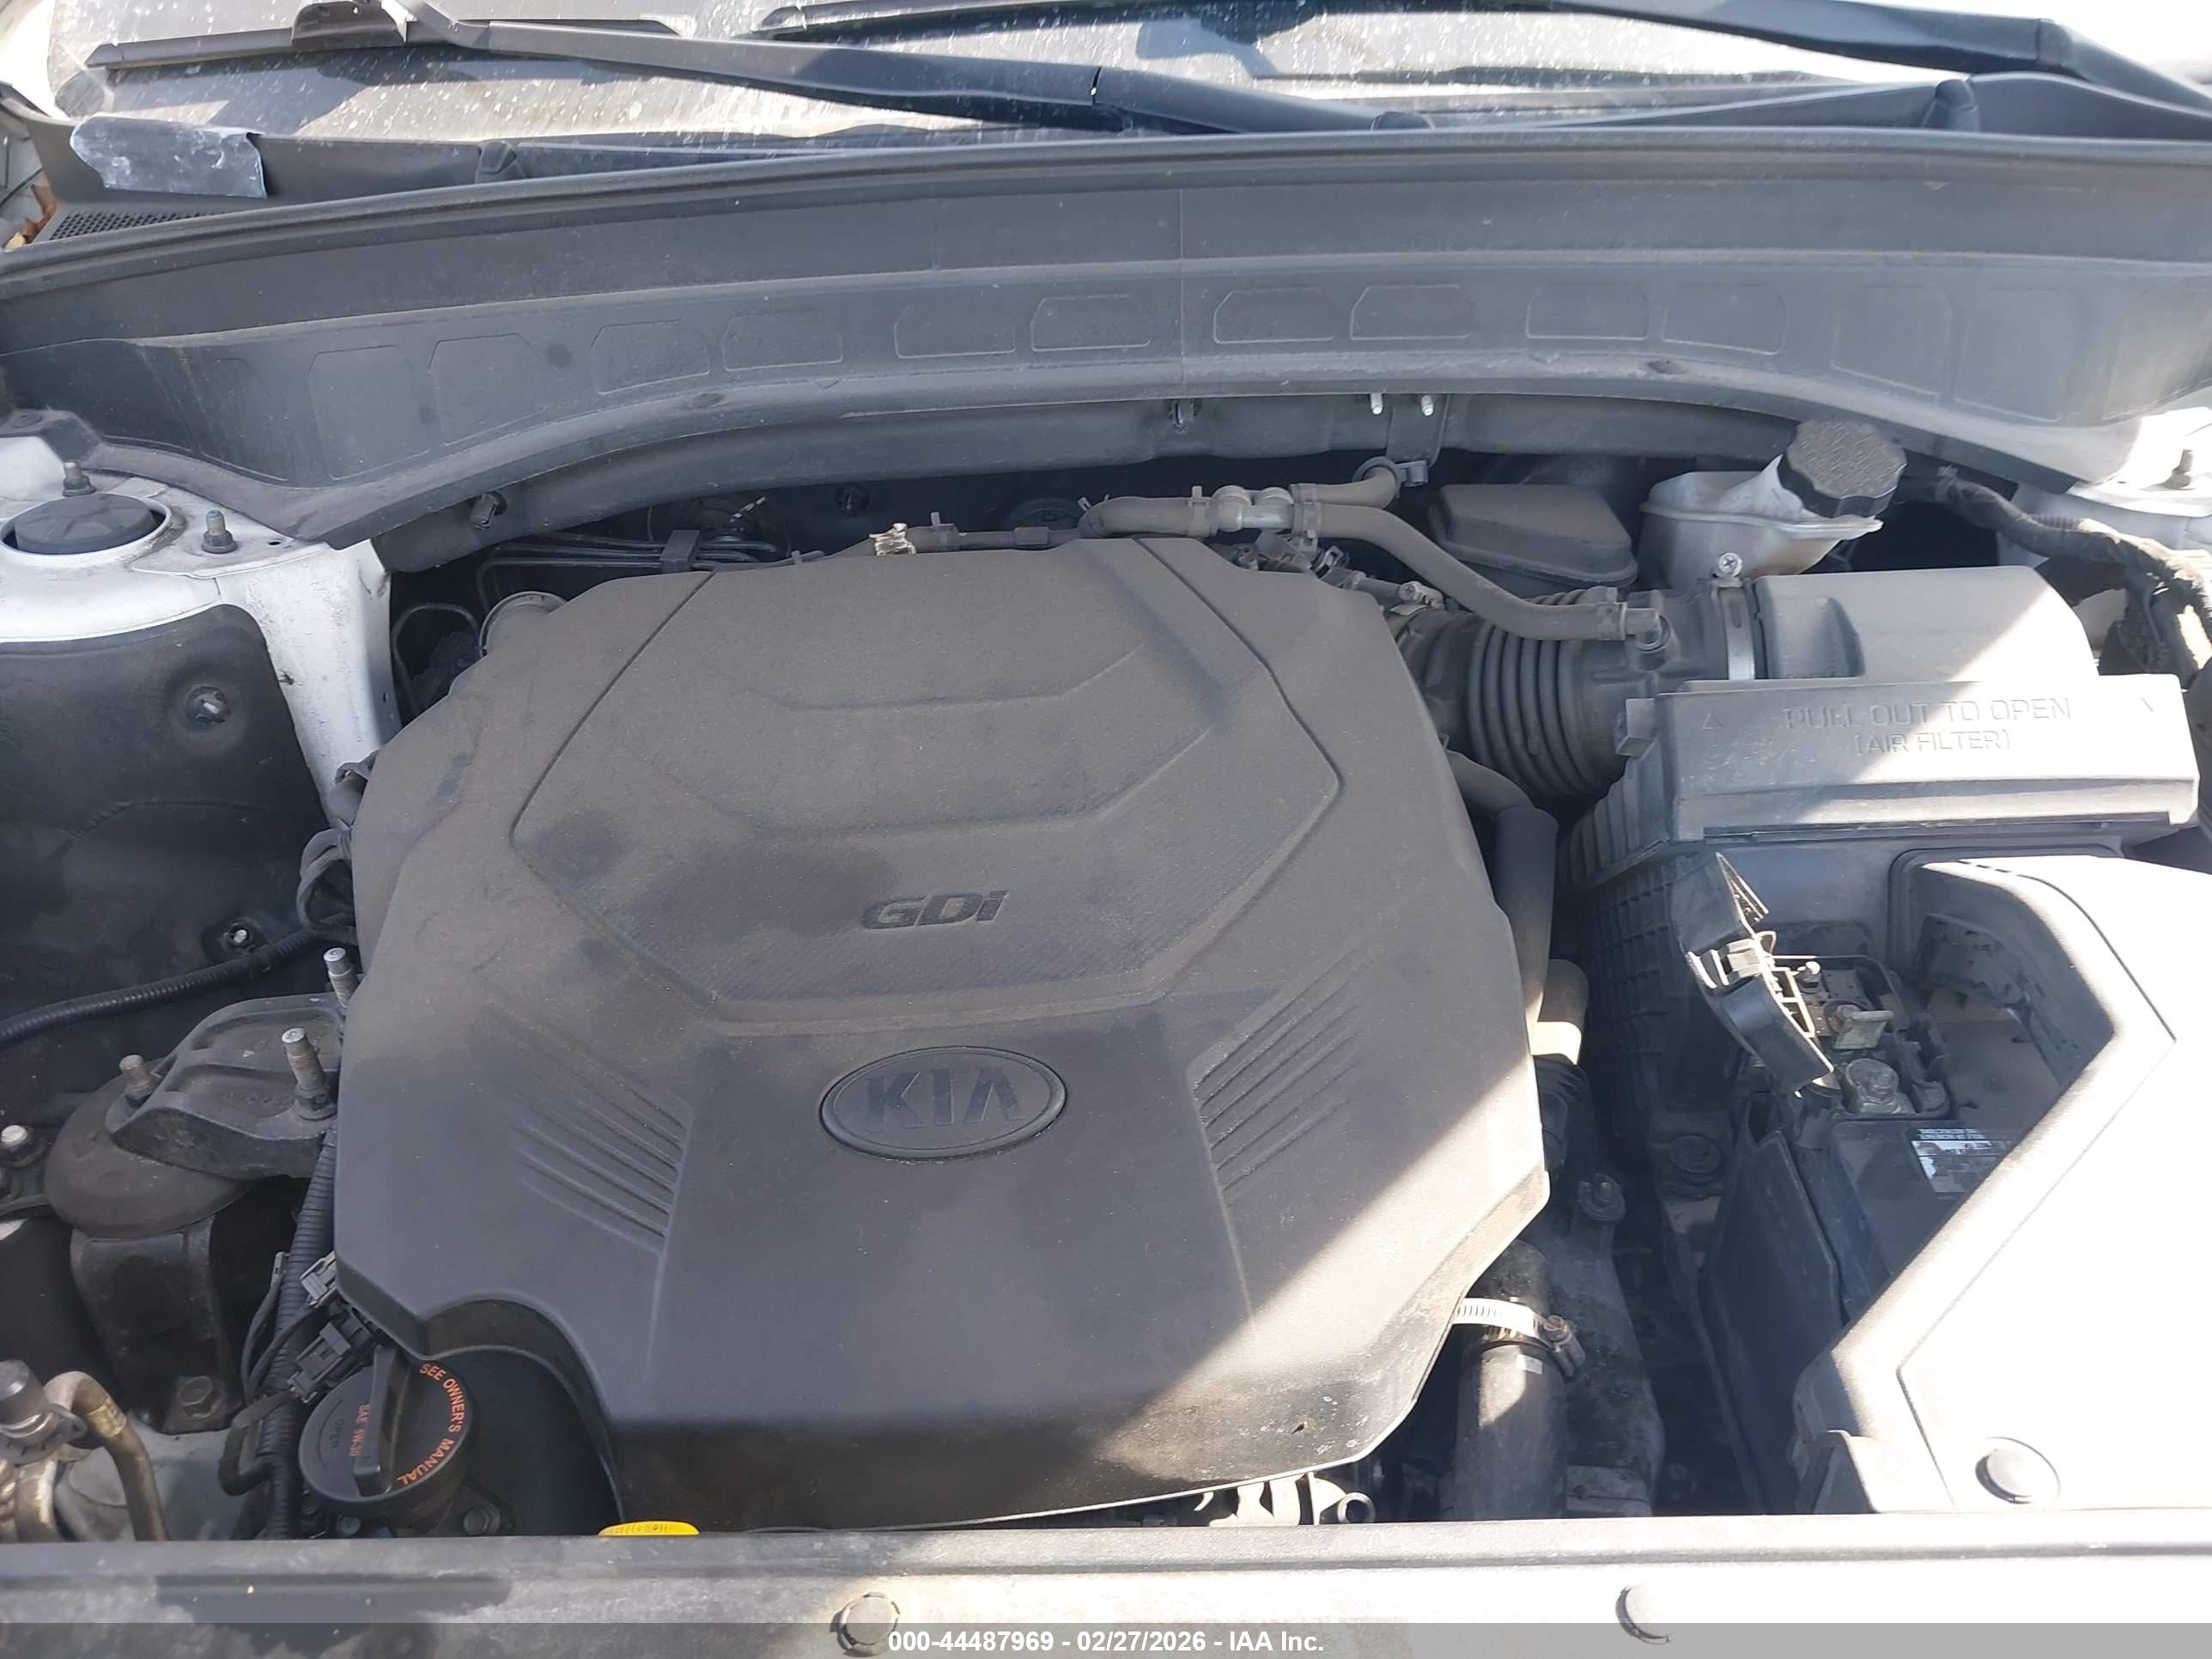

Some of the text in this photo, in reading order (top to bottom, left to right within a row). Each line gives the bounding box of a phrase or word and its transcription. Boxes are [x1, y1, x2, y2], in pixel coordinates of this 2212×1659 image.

[1783, 697, 2071, 730] PULL OUT TO OPEN
[864, 1065, 1024, 1133] KIA
[397, 1363, 465, 1485] SEE OWNER'S MANUAL
